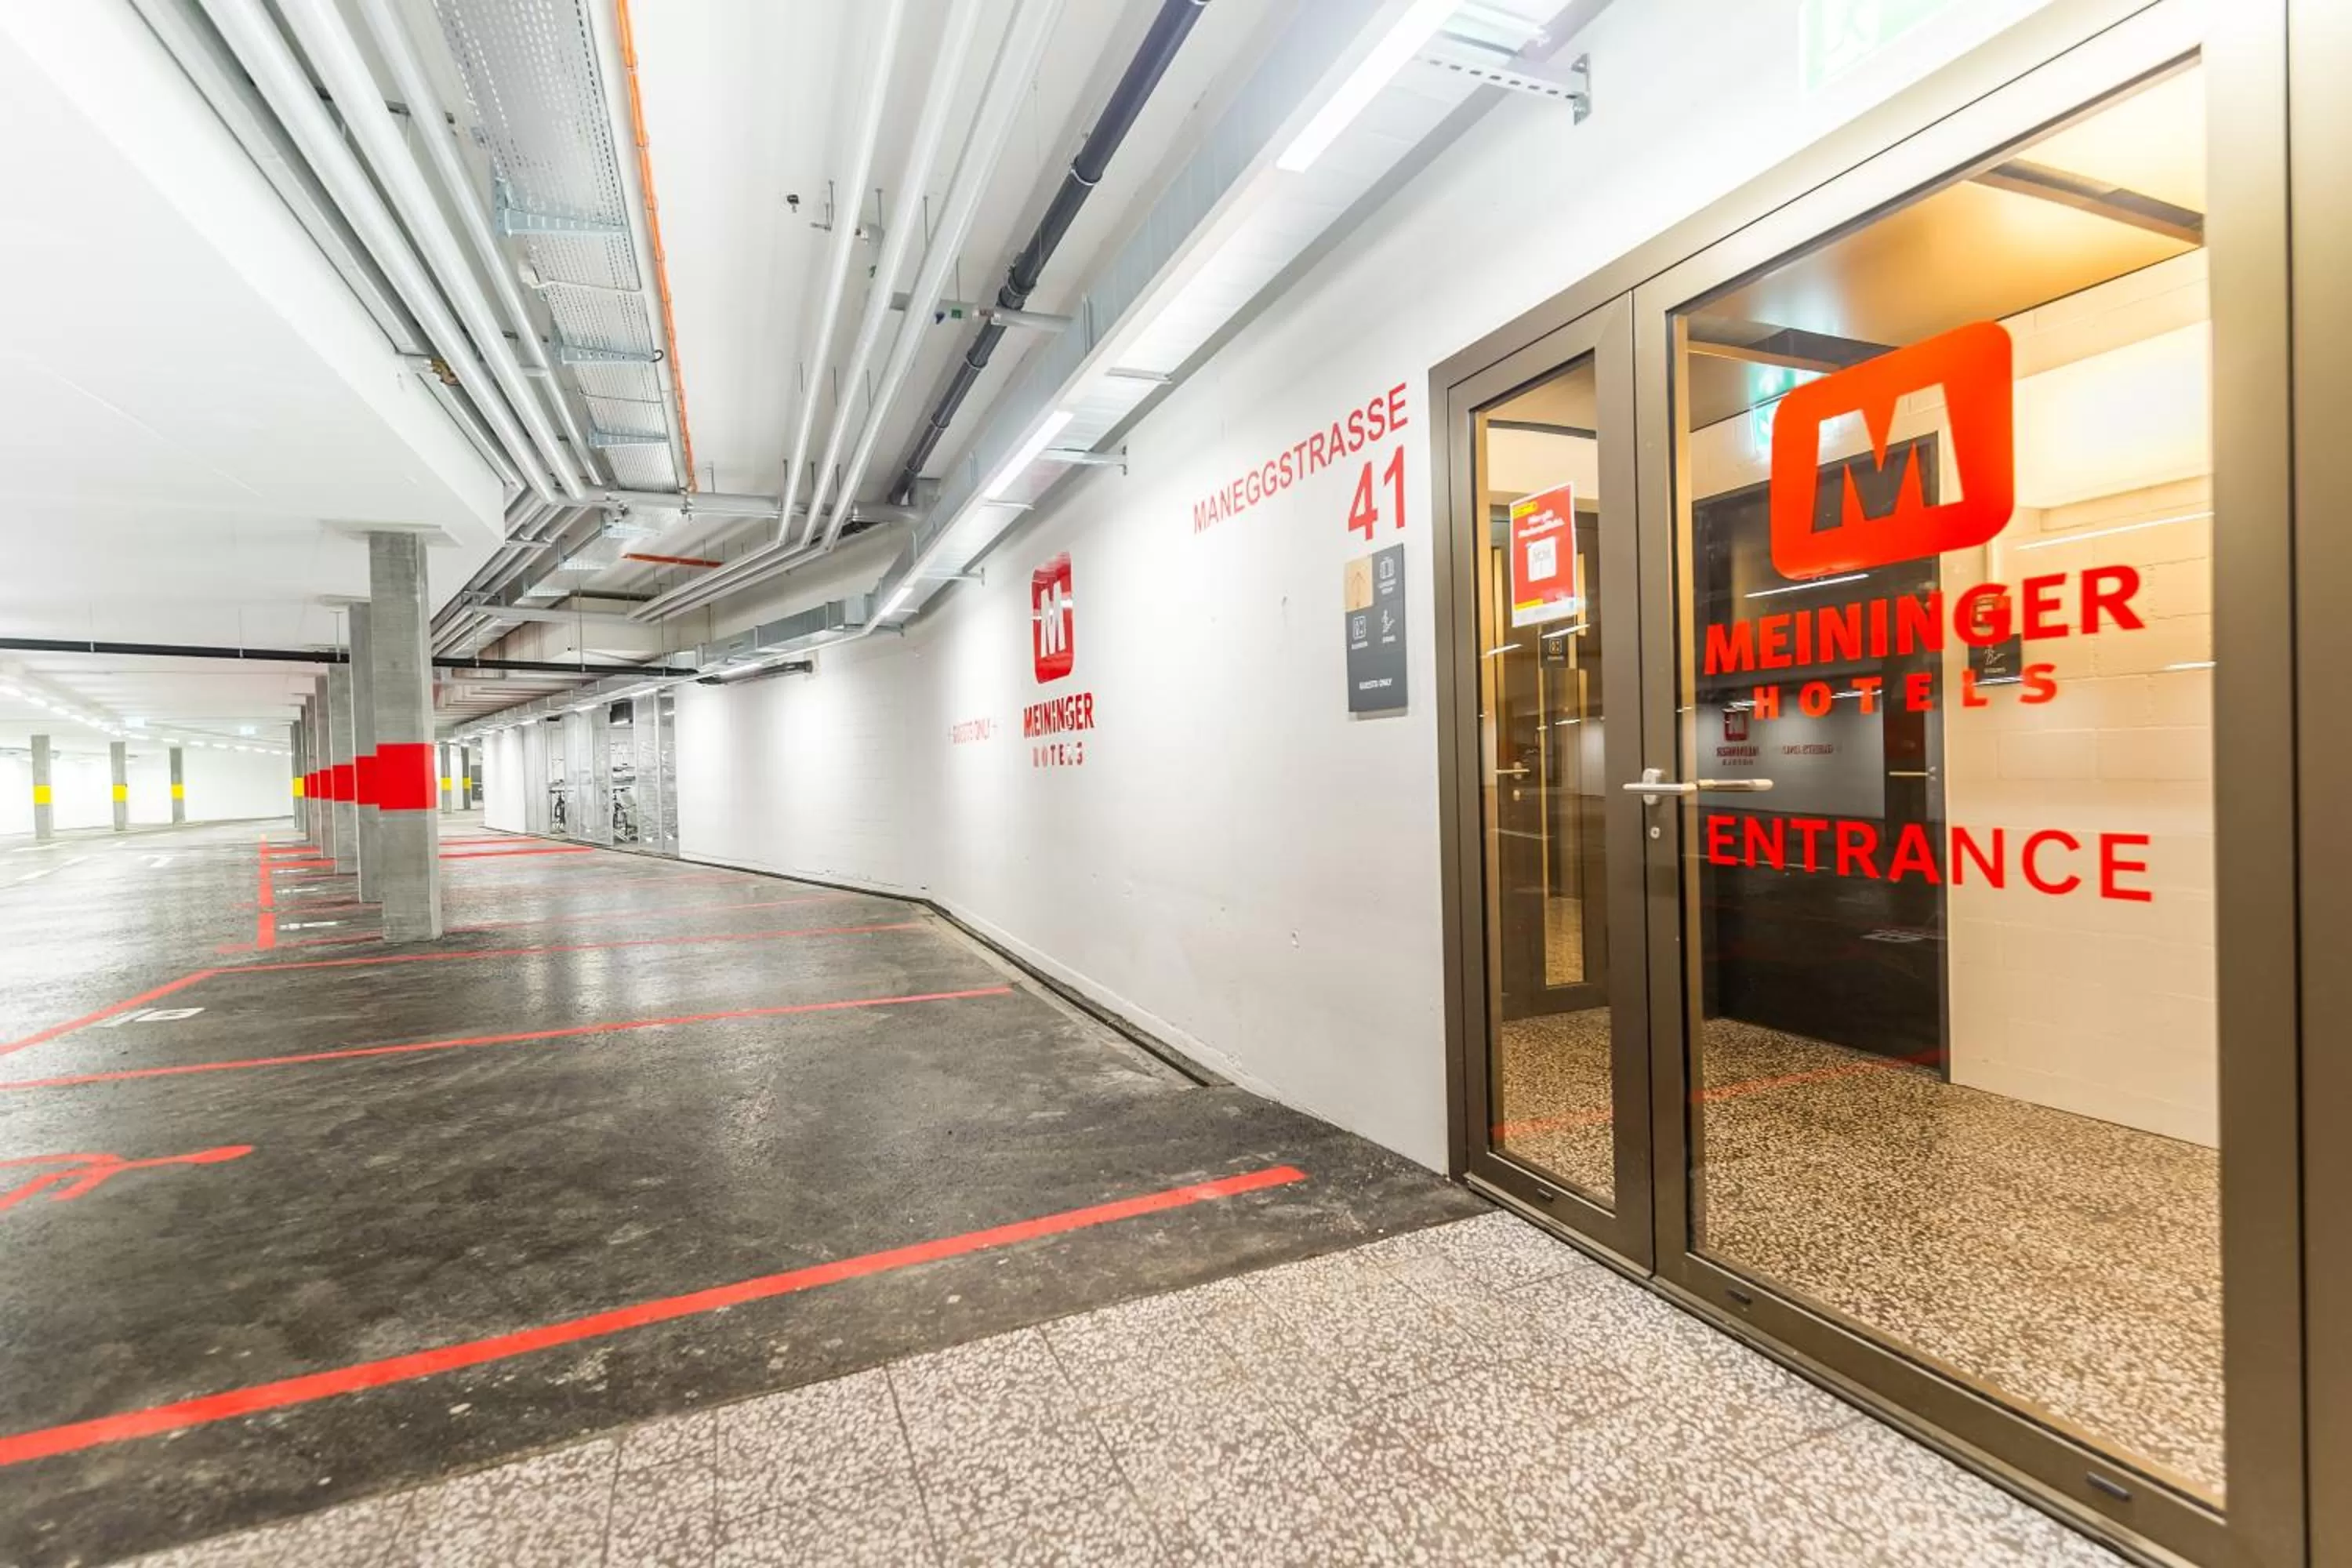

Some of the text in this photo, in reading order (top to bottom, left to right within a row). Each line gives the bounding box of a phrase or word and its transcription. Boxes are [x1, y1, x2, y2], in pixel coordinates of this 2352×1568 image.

[1193, 381, 1409, 535] MANEGGSTRASSE
[1347, 444, 1406, 542] 41
[1704, 564, 2146, 676] MEININGER
[1023, 691, 1094, 739] MEININGER
[1754, 662, 2058, 720] HOTELS
[1708, 815, 2153, 902] ENTRANCE
